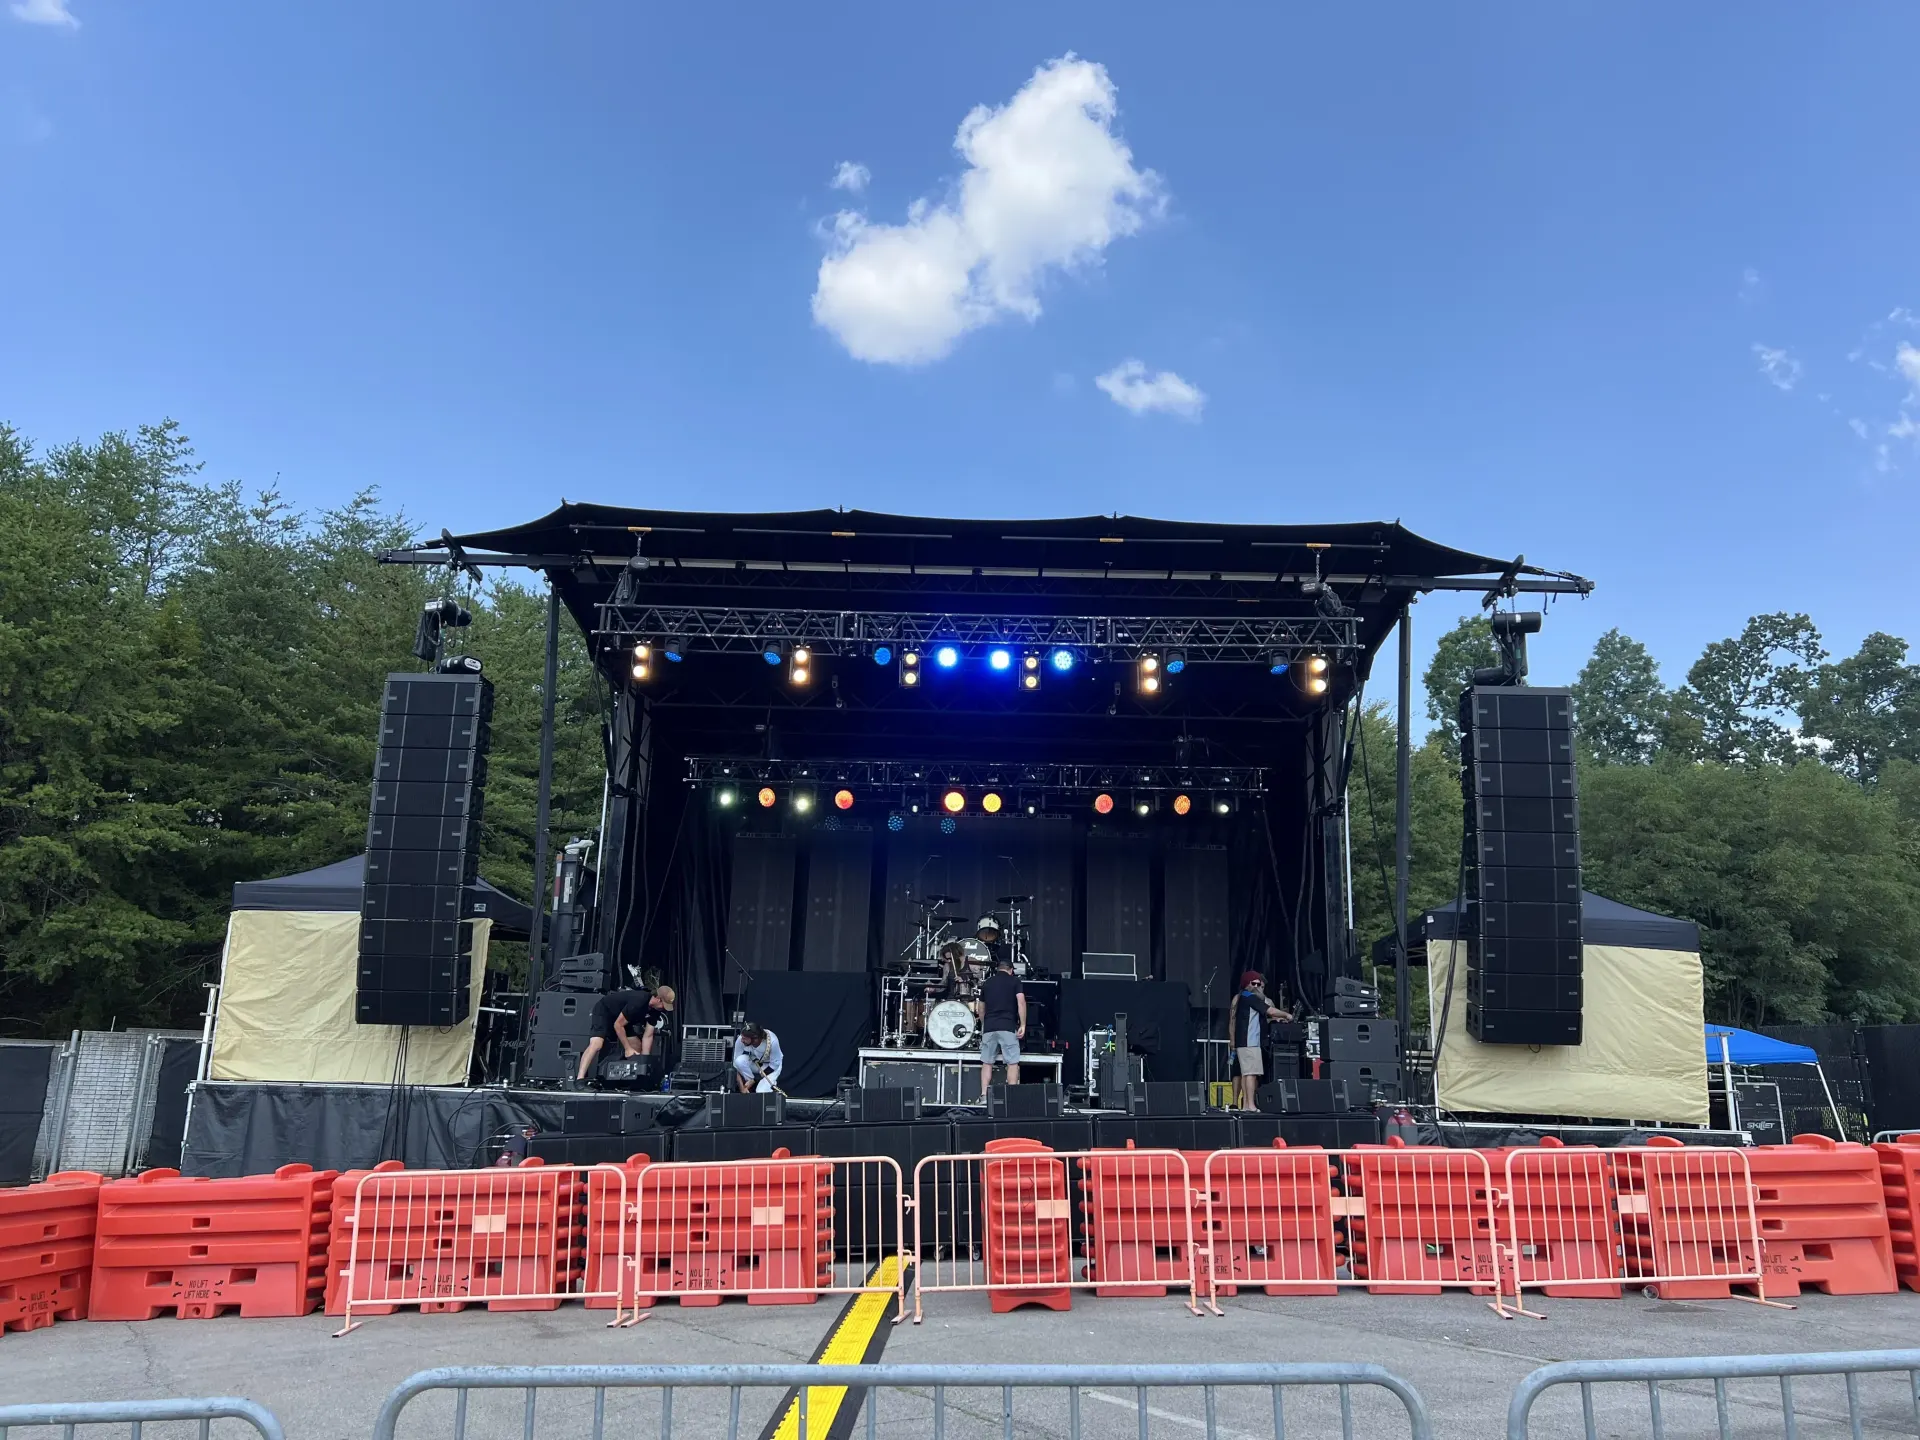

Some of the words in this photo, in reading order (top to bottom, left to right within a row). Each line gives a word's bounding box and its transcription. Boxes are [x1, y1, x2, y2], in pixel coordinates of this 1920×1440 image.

[1746, 1121, 1775, 1131] SKILLET
[188, 1280, 197, 1289] NO
[197, 1279, 209, 1289] LIFT
[184, 1290, 195, 1299] LIFT
[195, 1289, 210, 1299] HERE
